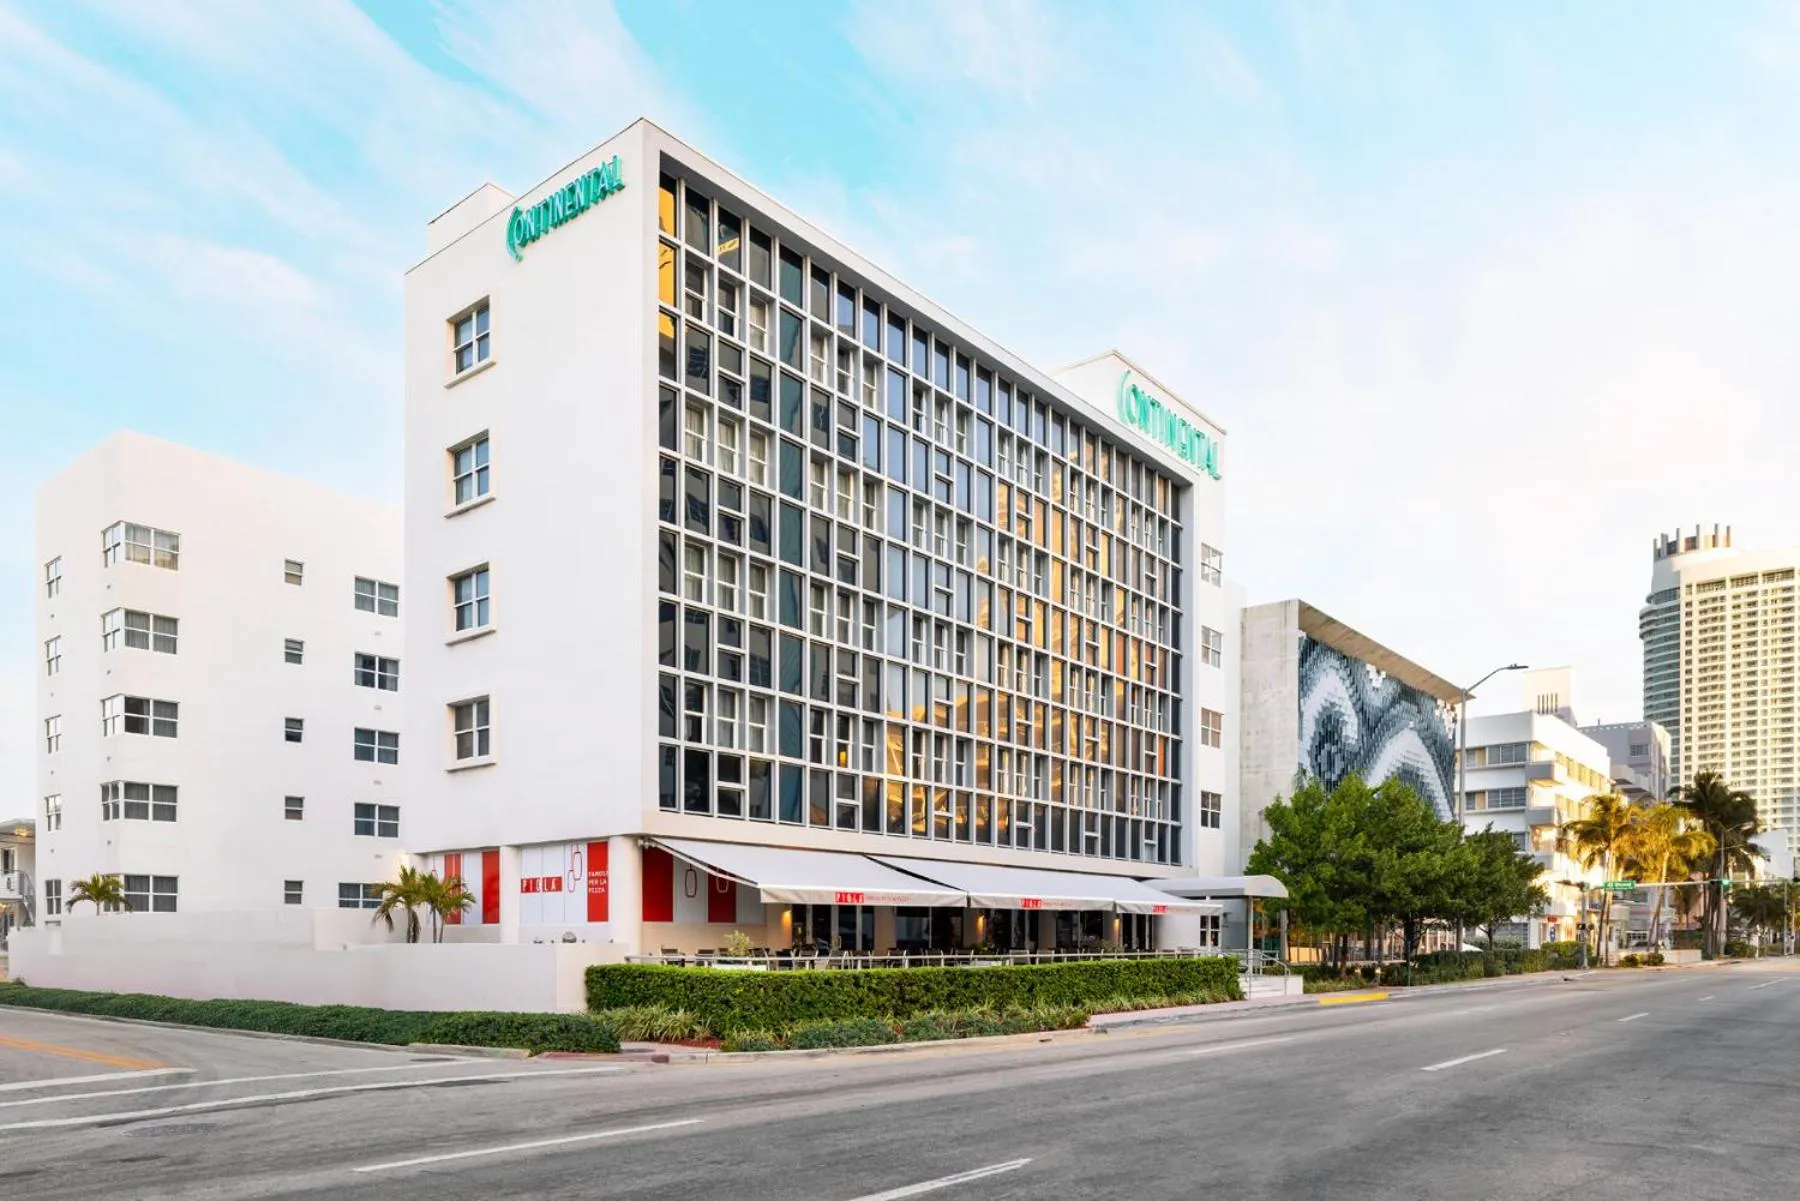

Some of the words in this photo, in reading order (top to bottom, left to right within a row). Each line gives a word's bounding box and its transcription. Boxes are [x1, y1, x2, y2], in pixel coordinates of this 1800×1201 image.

[506, 154, 625, 261] CONTINENTAL
[1117, 370, 1222, 480] CONTINENTAL
[522, 879, 557, 891] PIOLA
